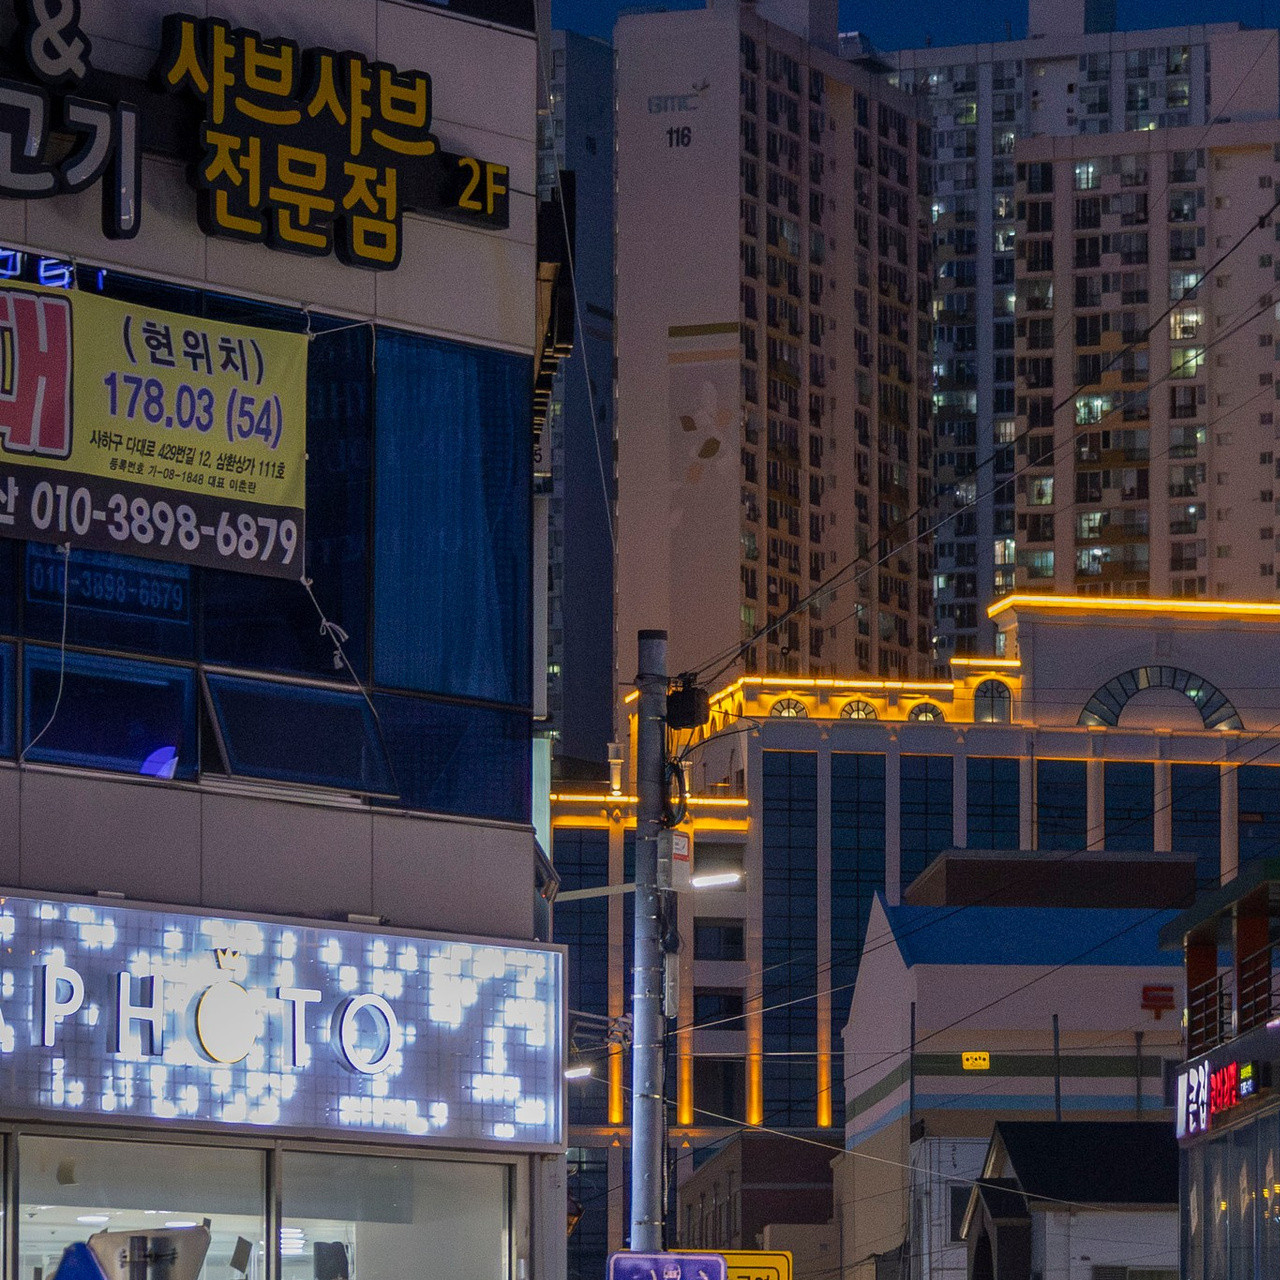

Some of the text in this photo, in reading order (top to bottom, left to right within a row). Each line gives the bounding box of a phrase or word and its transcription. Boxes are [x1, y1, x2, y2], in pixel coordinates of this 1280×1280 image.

[166, 20, 436, 157] 샤브샤브
[666, 126, 692, 148] 116
[204, 131, 398, 265] 전문점
[457, 157, 507, 215] 2F
[123, 315, 265, 385] (현위치)
[103, 371, 284, 450] 178.03 (54)
[89, 429, 124, 452] 사하구
[125, 436, 156, 458] 다대로
[157, 441, 197, 466] 429번길
[216, 451, 257, 477] 삼환상가
[258, 460, 287, 480] 111호
[30, 480, 298, 565] 010-3898-6879
